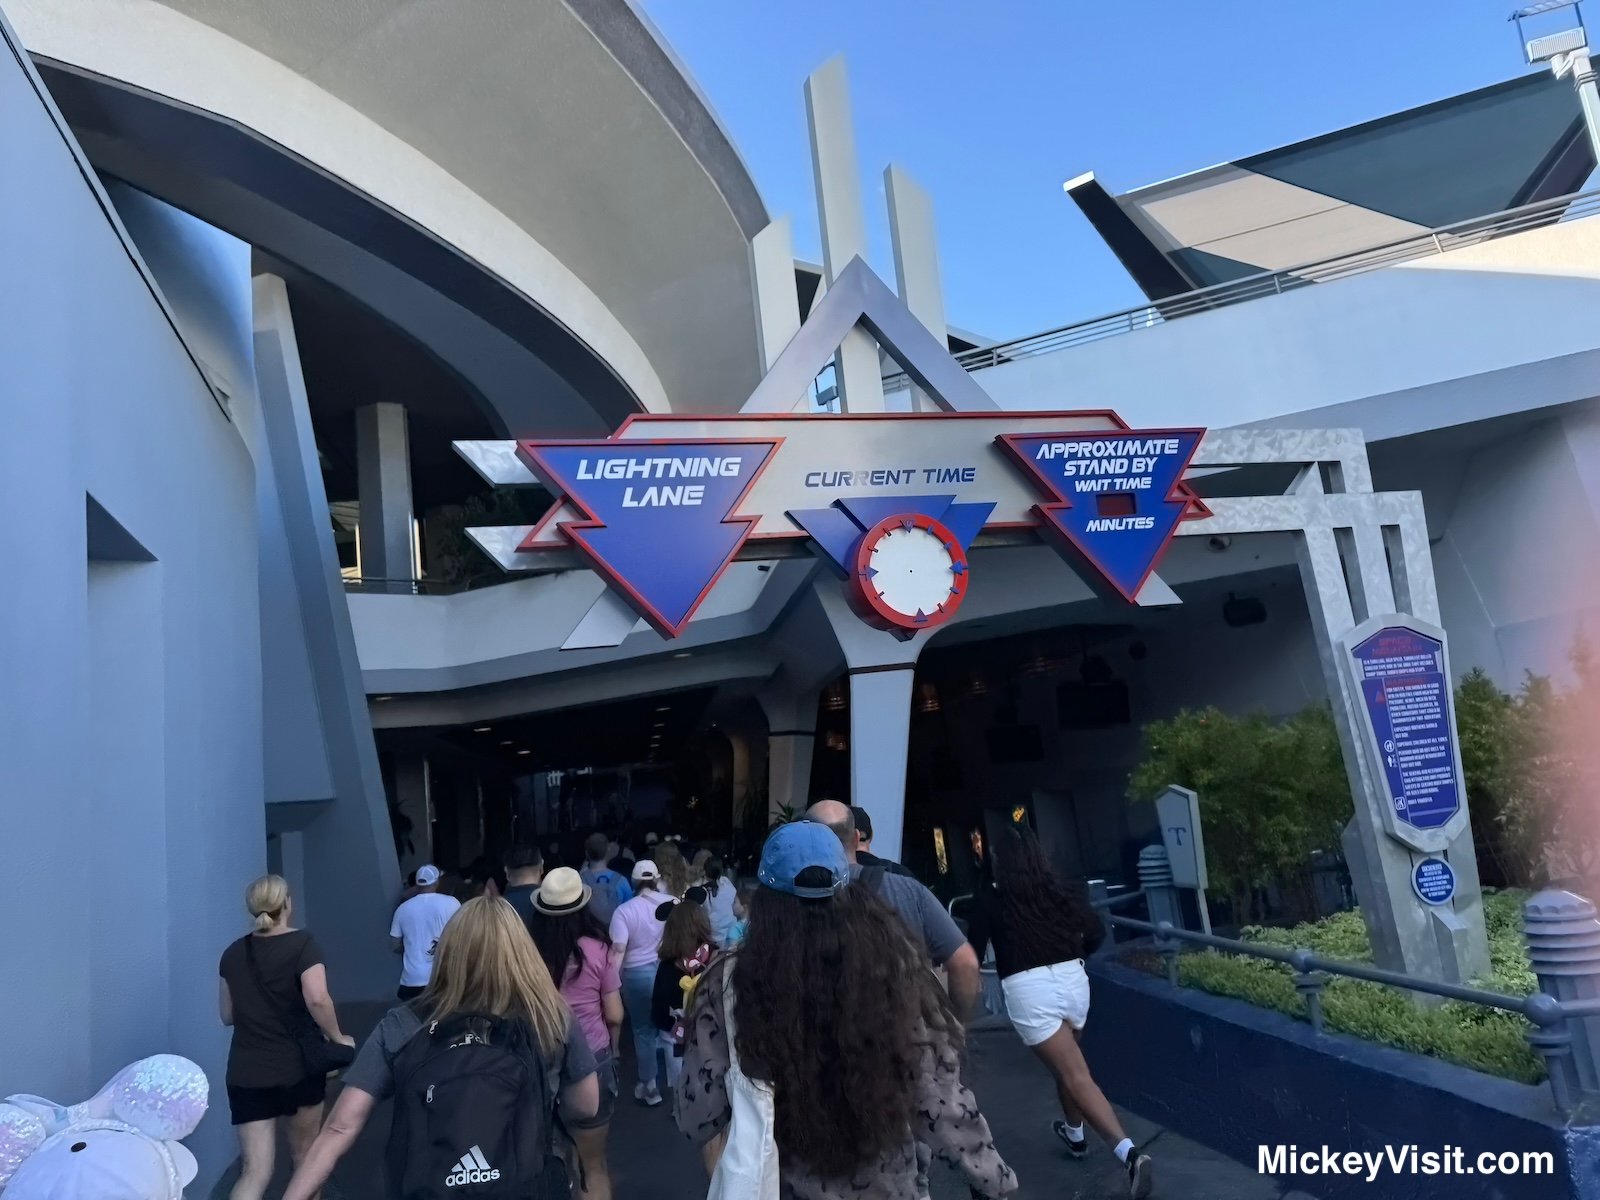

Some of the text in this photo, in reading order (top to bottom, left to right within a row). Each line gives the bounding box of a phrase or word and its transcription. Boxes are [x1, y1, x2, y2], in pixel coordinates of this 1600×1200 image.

[1036, 439, 1179, 460] APPROXIMATE
[576, 457, 742, 480] LIGHTNING
[1063, 457, 1158, 476] STAND BY
[804, 467, 976, 488] CURRENT TIME
[1075, 477, 1152, 493] WAIT TIME
[622, 485, 706, 508] LANE
[1085, 516, 1155, 532] MINUTES
[445, 1167, 501, 1187] adidas
